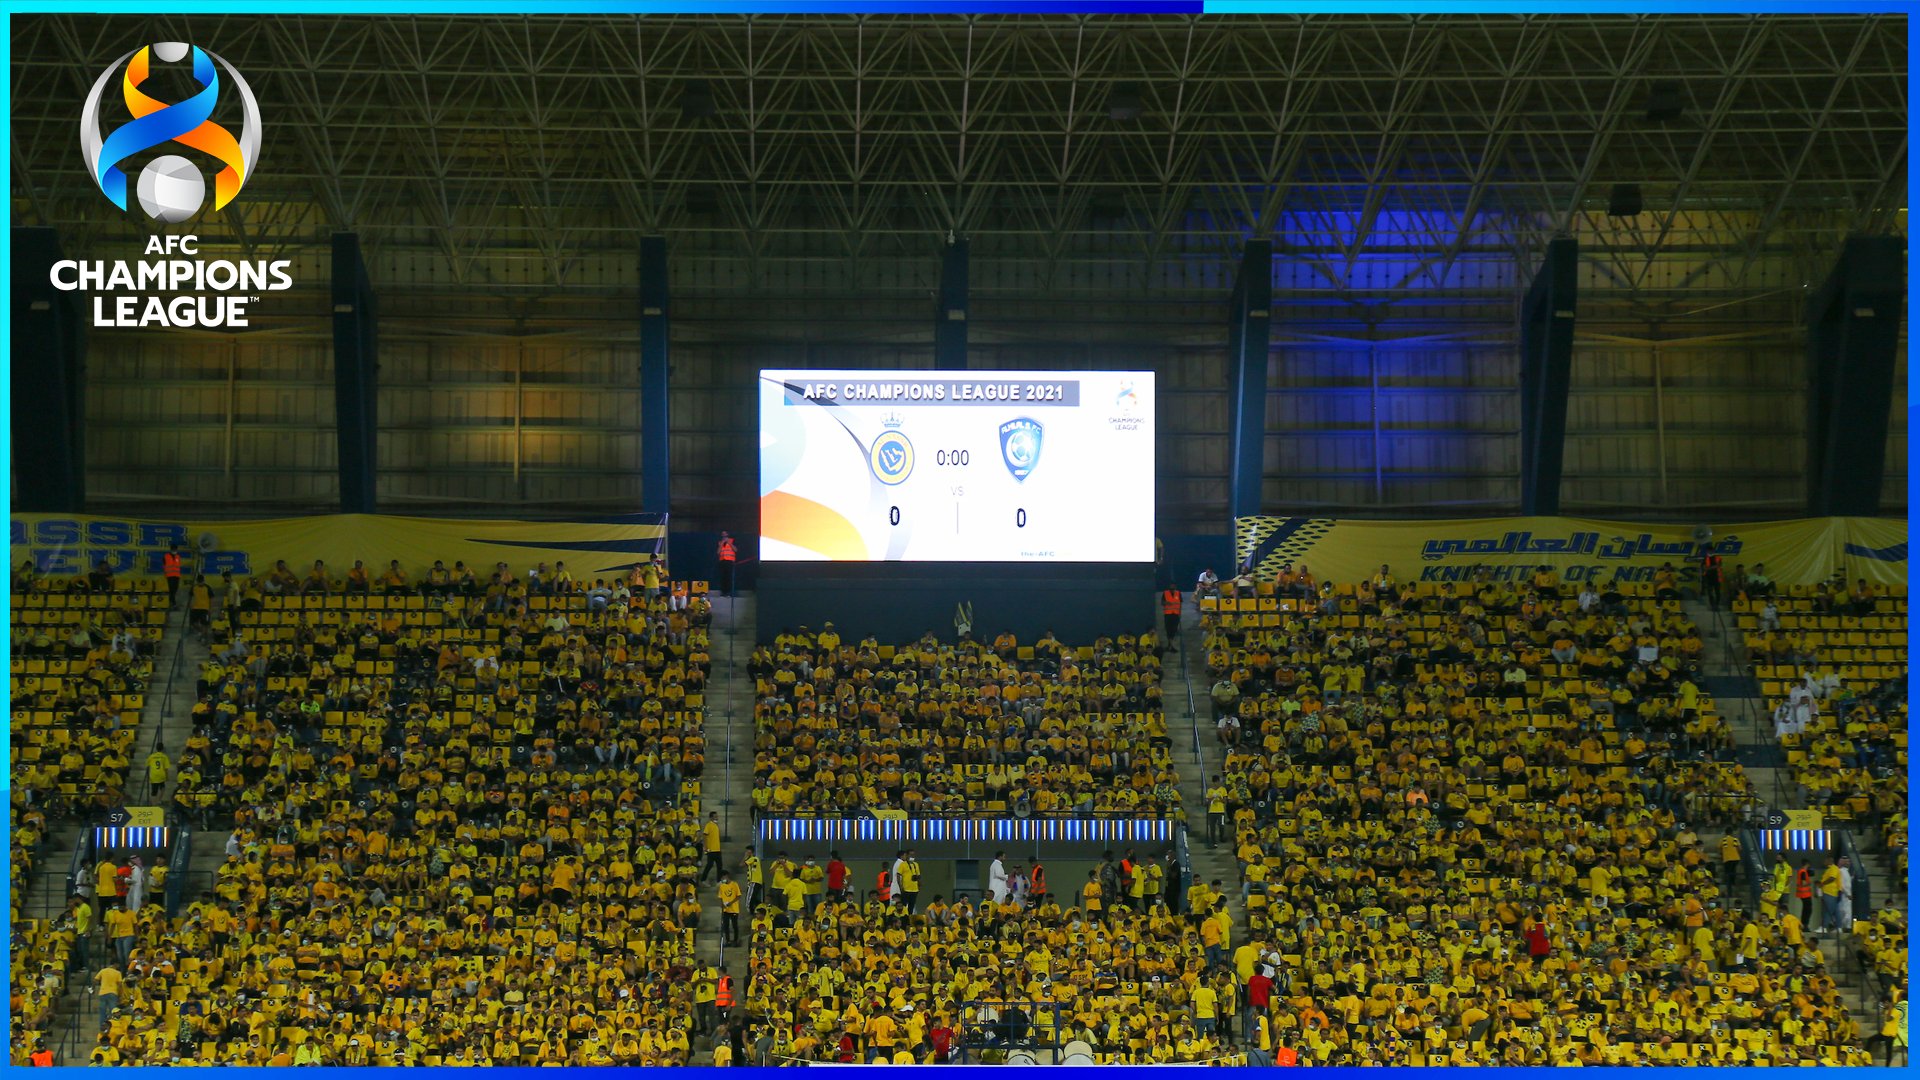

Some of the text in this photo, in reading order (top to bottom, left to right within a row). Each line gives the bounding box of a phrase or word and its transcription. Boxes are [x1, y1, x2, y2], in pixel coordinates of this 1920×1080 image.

[803, 383, 1064, 401] AFC CHAMPIONS LEAGUE 2021
[936, 449, 970, 466] 0:00
[951, 486, 964, 496] VS
[889, 505, 900, 526] 0
[1016, 507, 1027, 528] 0
[1420, 565, 1557, 582] KNIHT
[1564, 565, 1608, 581] OF
[156, 760, 161, 769] 9
[110, 813, 123, 822] S7
[1770, 816, 1782, 824] S9
